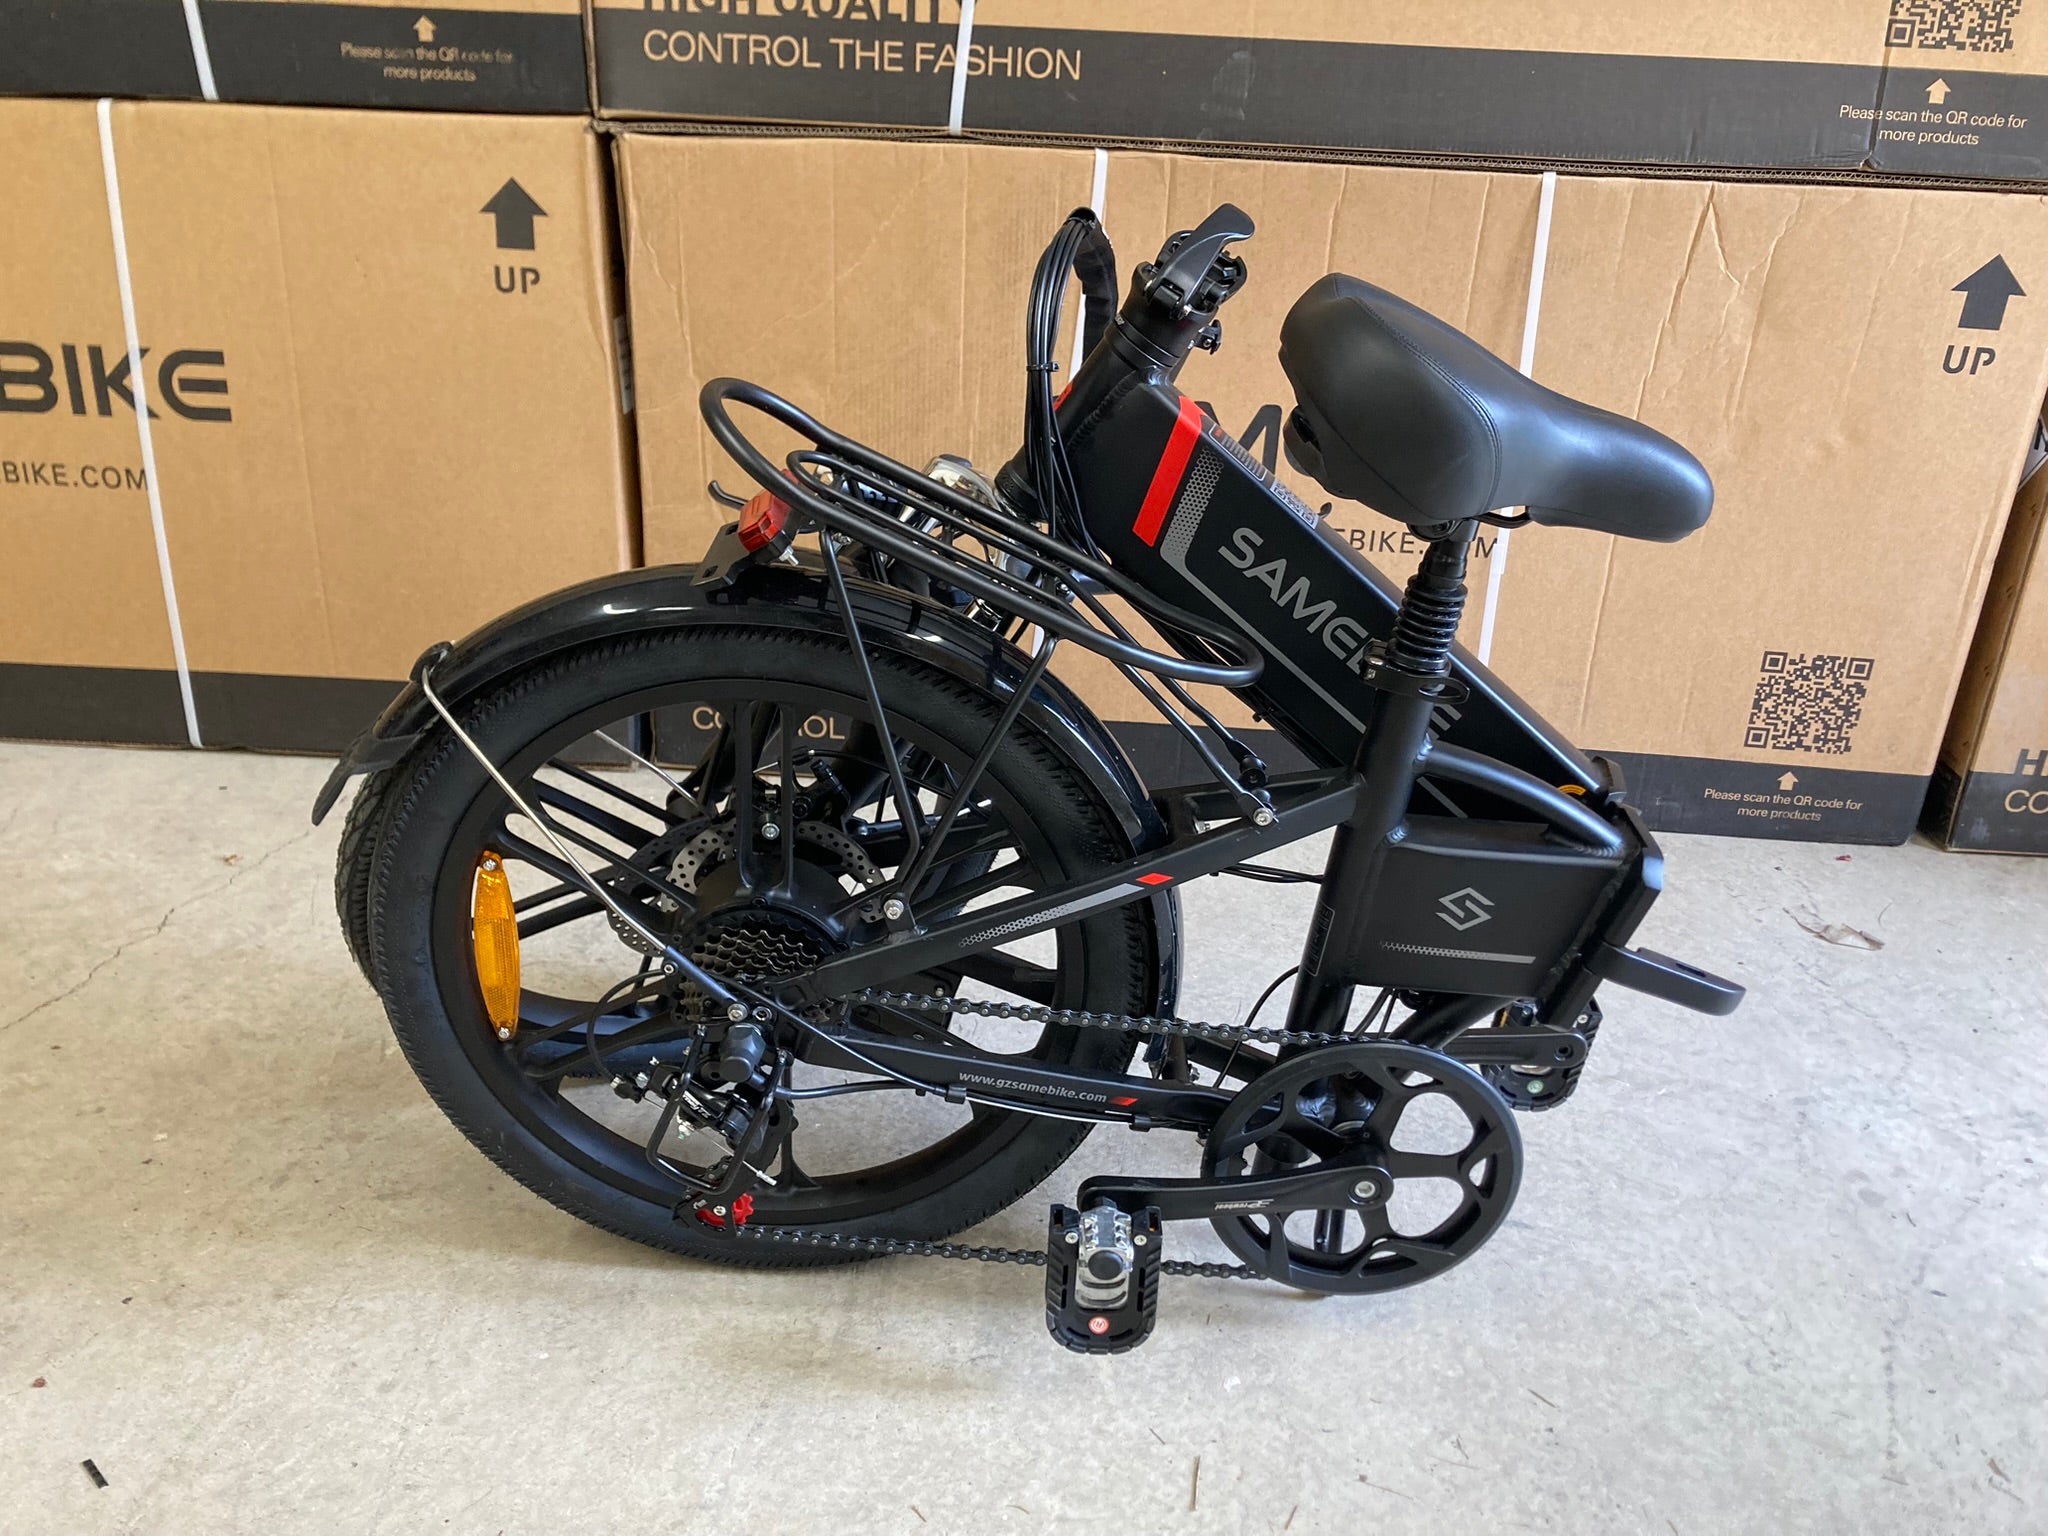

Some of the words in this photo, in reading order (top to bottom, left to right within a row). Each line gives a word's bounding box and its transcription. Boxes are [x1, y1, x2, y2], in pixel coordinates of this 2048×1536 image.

[415, 46, 437, 61] the
[438, 46, 459, 63] QR
[643, 28, 822, 69] CONTROL
[829, 37, 904, 73] THE
[915, 42, 1082, 80] FASHION
[383, 65, 418, 80] more
[419, 66, 477, 82] products
[1839, 104, 1883, 120] Please
[1885, 110, 1918, 122] scan
[1921, 109, 1943, 124] the
[1945, 110, 1969, 126] QR
[1970, 113, 2005, 127] code
[2007, 114, 2028, 129] for
[1878, 129, 1915, 142] more
[1918, 130, 1979, 146] products
[493, 265, 541, 295] UP
[1942, 344, 1997, 376] UP
[1703, 788, 1741, 801] Please
[1743, 793, 1770, 804] scan
[1773, 794, 1791, 805] the
[1793, 795, 1813, 807] QR
[1814, 798, 1843, 810] code
[1845, 799, 1863, 811] for
[1737, 806, 1768, 818] more
[1770, 809, 1822, 822] products
[959, 1071, 1108, 1104] www.gzsamebike.com
